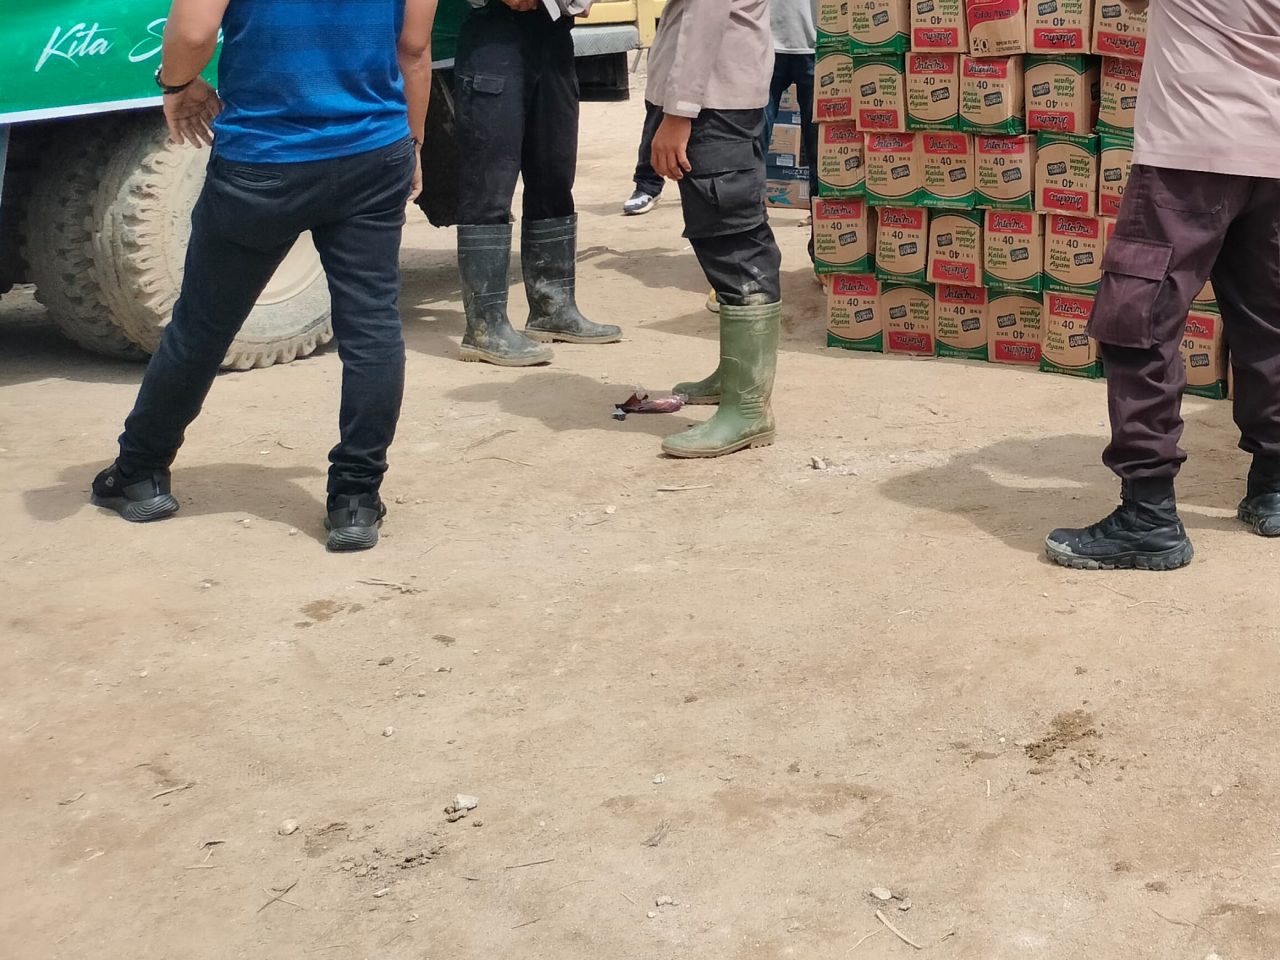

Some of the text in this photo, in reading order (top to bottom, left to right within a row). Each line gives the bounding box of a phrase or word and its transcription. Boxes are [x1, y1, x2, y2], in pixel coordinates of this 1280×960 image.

[1052, 18, 1066, 26] 40
[1116, 22, 1129, 31] 40
[35, 23, 117, 72] Kita
[976, 81, 988, 89] 40
[1115, 83, 1126, 92] 40
[873, 99, 884, 107] 40
[1046, 100, 1058, 108] 40
[838, 147, 849, 155] 40
[883, 155, 894, 163] 40
[940, 157, 951, 165] 40
[993, 158, 1005, 166] 40
[1062, 179, 1074, 188] 40
[831, 222, 842, 230] 40
[891, 231, 903, 239] 40
[1002, 236, 1014, 244] 40
[1066, 240, 1078, 248] 40
[949, 250, 960, 258] 40
[847, 298, 858, 306] 40
[953, 307, 965, 315] 40
[904, 322, 915, 330] 40
[1062, 320, 1074, 330] 40
[1012, 330, 1024, 339] 40
[1182, 341, 1194, 349] 40
